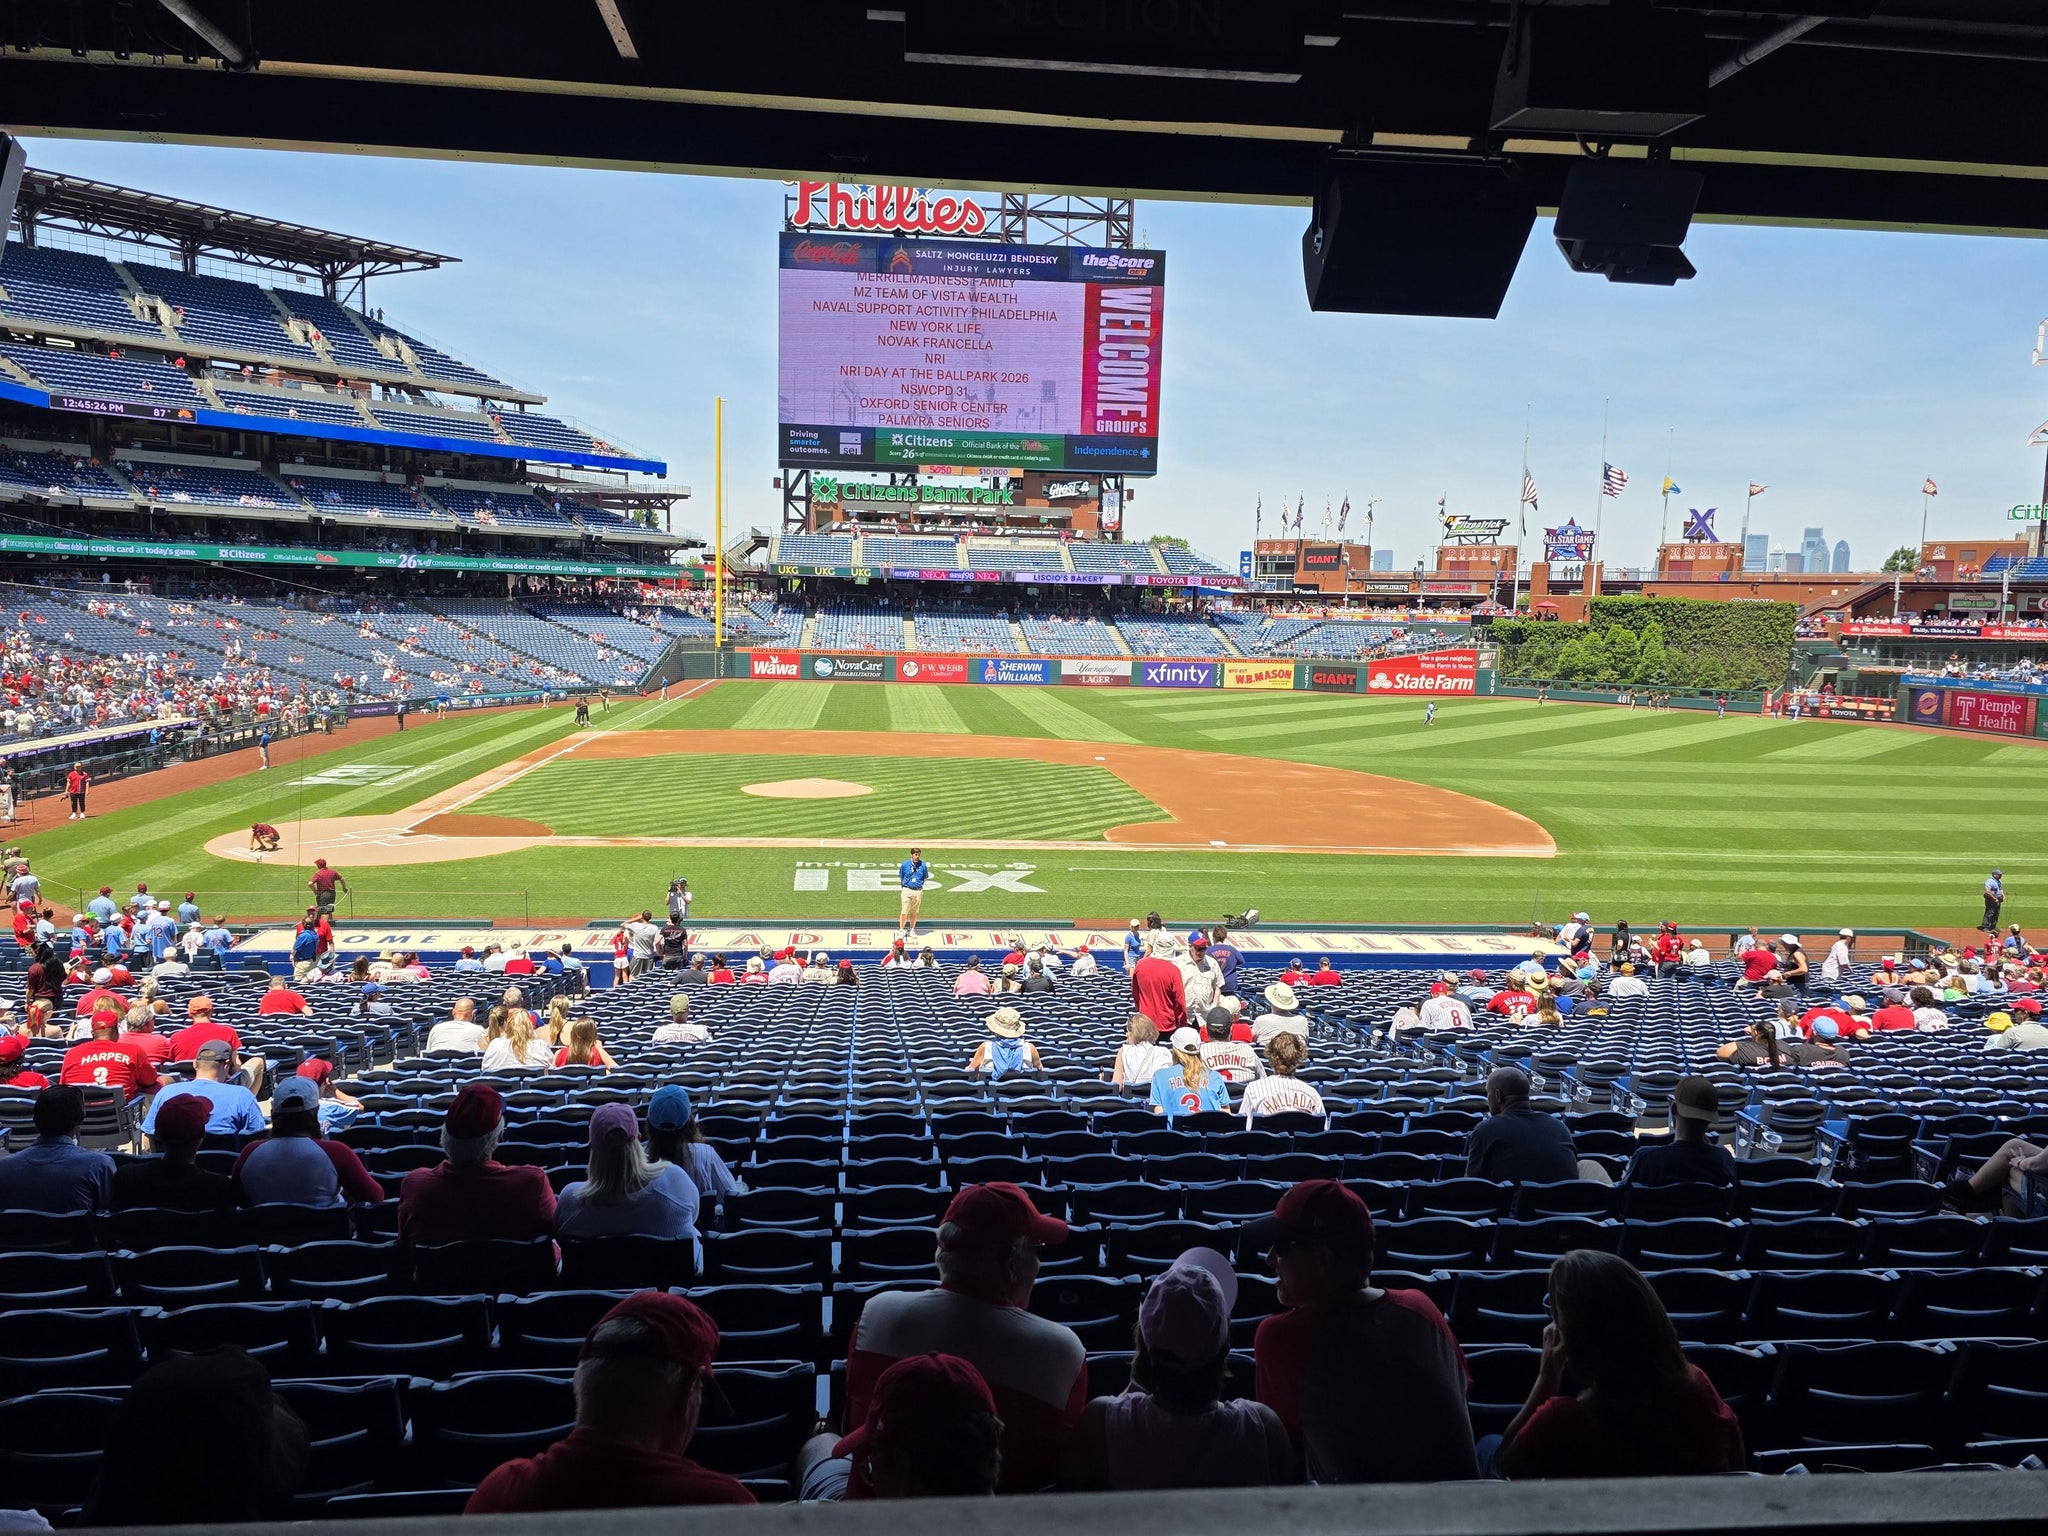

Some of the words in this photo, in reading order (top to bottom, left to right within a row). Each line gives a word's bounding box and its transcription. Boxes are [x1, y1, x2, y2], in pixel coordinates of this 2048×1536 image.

[783, 180, 987, 235] Phillies
[915, 249, 943, 259] SALTZ
[947, 251, 1007, 262] MONGELUZZI
[1011, 254, 1059, 265] BENDESKY
[1082, 254, 1155, 269] theScore
[943, 264, 979, 273] INJURY
[986, 267, 1031, 276] LAWYERS
[857, 272, 969, 286] MERRILLMADNESS
[973, 277, 1016, 289] FAMILY
[854, 286, 872, 298] MZ
[875, 287, 908, 299] TEAM
[912, 289, 928, 300] OF
[931, 290, 966, 301] VISTA
[968, 292, 1018, 304] WEALTH
[813, 300, 853, 312] NAVAL
[856, 303, 912, 315] SUPPORT
[915, 305, 968, 317] ACTIVITY
[972, 308, 1058, 322] PHILADELPHIA
[890, 320, 917, 331] NEW
[921, 321, 953, 333] YORK
[957, 323, 981, 334] LIFE
[877, 335, 919, 347] NOVAK
[923, 337, 993, 350] FRANCELLA
[925, 353, 945, 364] NRI
[1096, 287, 1153, 418] WELCOME
[840, 366, 861, 376] NRI
[864, 367, 889, 377] DAY
[892, 368, 907, 378] AT
[910, 368, 933, 380] THE
[937, 370, 998, 382] BALLPARK
[1001, 372, 1029, 383] 2026
[901, 384, 953, 396] NSWCPD
[956, 385, 968, 396] 31
[63, 398, 107, 411] 12:45:24
[109, 402, 124, 413] PM
[860, 398, 909, 410] OXFORD
[913, 400, 957, 412] SENIOR
[961, 402, 1008, 414] CENTER
[878, 414, 934, 427] PALMYRA
[938, 416, 991, 429] SENIORS
[1096, 420, 1147, 434] GROUPS
[790, 430, 818, 440] Driving
[905, 434, 953, 447] Citizens
[790, 438, 820, 446] smarter
[962, 440, 985, 449] Official
[986, 441, 1001, 449] Bank
[1002, 441, 1010, 450] of
[1010, 442, 1020, 450] the
[790, 446, 830, 454] outcomes.
[1074, 445, 1138, 457] Independence
[979, 468, 1009, 476] $10,000
[842, 482, 918, 502] Citizens
[922, 485, 969, 503] Bank
[972, 487, 1014, 505] Park
[1049, 480, 1083, 499] GHOST
[1544, 535, 1557, 544] ALL
[1557, 535, 1575, 544] STAR
[1575, 535, 1595, 544] GAME
[92, 544, 115, 552] credit
[116, 545, 134, 553] card
[145, 546, 173, 555] today's
[174, 548, 198, 556] game.
[229, 549, 266, 559] Citizens
[377, 556, 396, 565] Score
[432, 559, 465, 567] concessions
[466, 560, 478, 568] with
[478, 561, 491, 569] your
[492, 561, 513, 570] Citizens
[514, 562, 528, 570] debit
[1306, 555, 1337, 563] GIANT
[623, 567, 647, 576] Citizens
[778, 566, 799, 575] UKG
[814, 568, 835, 576] UKG
[851, 569, 871, 577] UKG
[922, 570, 947, 579] NECA
[975, 572, 1000, 580] NECA
[1033, 574, 1068, 582] LISCIO'S
[1070, 574, 1104, 582] BAKERY
[1151, 576, 1185, 585] TOYOTA
[1204, 577, 1238, 586] TOYOTA
[1862, 625, 1903, 634] Budweiser
[2004, 629, 2048, 638] Budweiser
[753, 660, 797, 676] Wawa
[834, 659, 883, 671] NovaCare
[941, 664, 963, 673] WEBB
[999, 660, 1043, 672] SHERWIN
[1075, 662, 1117, 675] Yuengling
[1082, 675, 1110, 683] LAGER
[1147, 663, 1209, 685] xfinity
[1313, 673, 1356, 685] GIANT
[1617, 694, 1631, 704] 401
[1831, 709, 1857, 717] TOYOTA
[1979, 698, 2021, 717] Temple
[1978, 715, 2017, 731] Health
[152, 927, 163, 938] 12
[342, 934, 440, 945] OME
[1450, 1009, 1462, 1026] 8
[81, 1052, 130, 1066] HARPER
[1202, 1053, 1247, 1069] ICTORINO
[1180, 1092, 1201, 1113] 3
[1263, 1092, 1316, 1114] HALLADA
